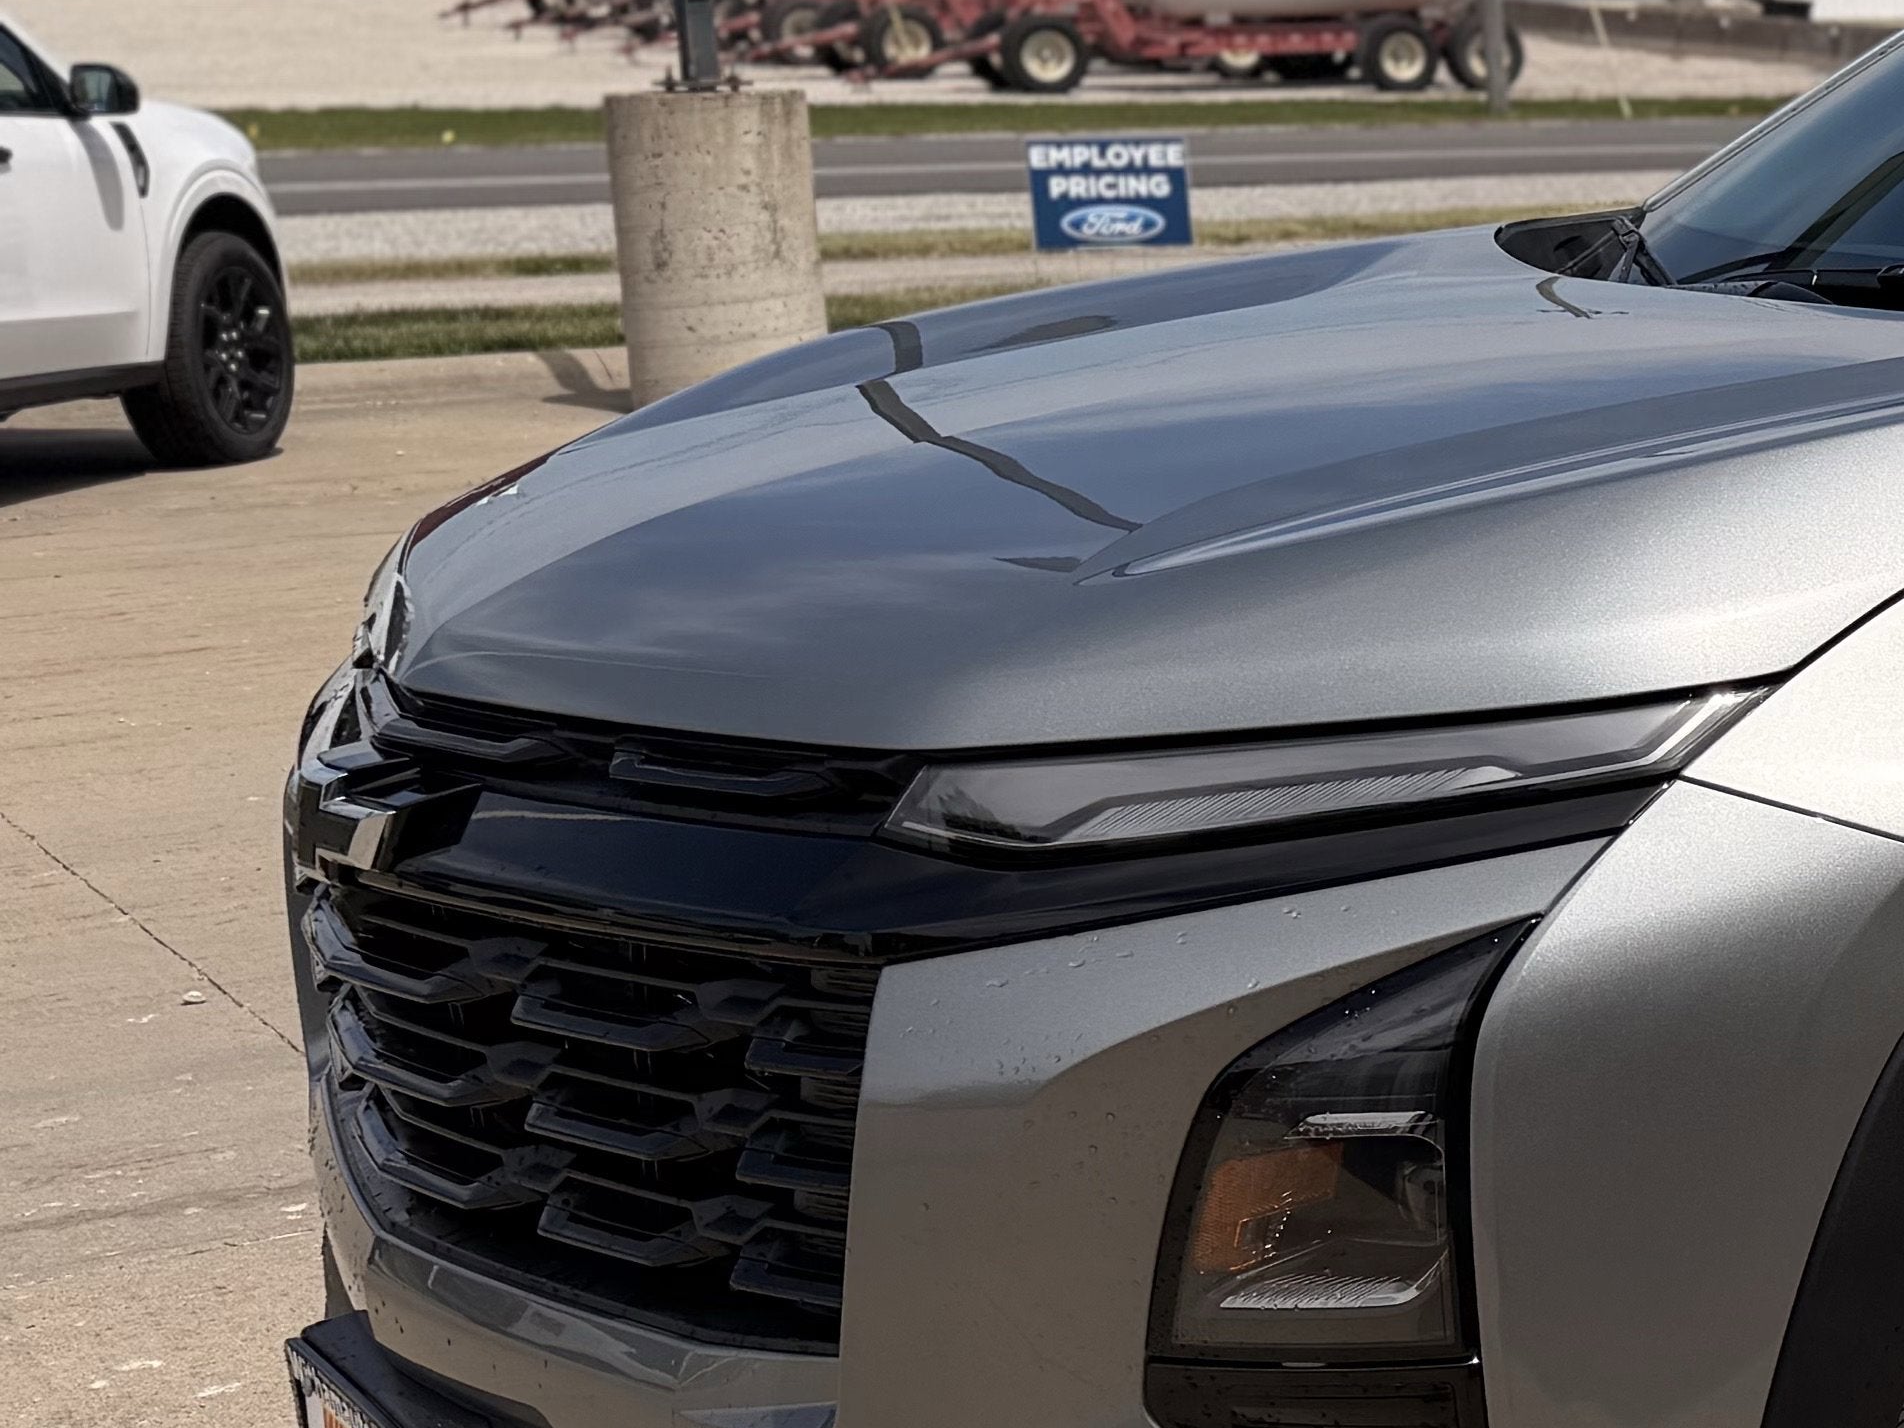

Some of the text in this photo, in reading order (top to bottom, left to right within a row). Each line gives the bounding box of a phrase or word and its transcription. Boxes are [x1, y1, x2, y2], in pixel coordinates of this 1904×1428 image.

[1028, 143, 1185, 169] EMPLOYEE
[1048, 173, 1171, 200] PRICING
[1081, 210, 1144, 236] Ford
